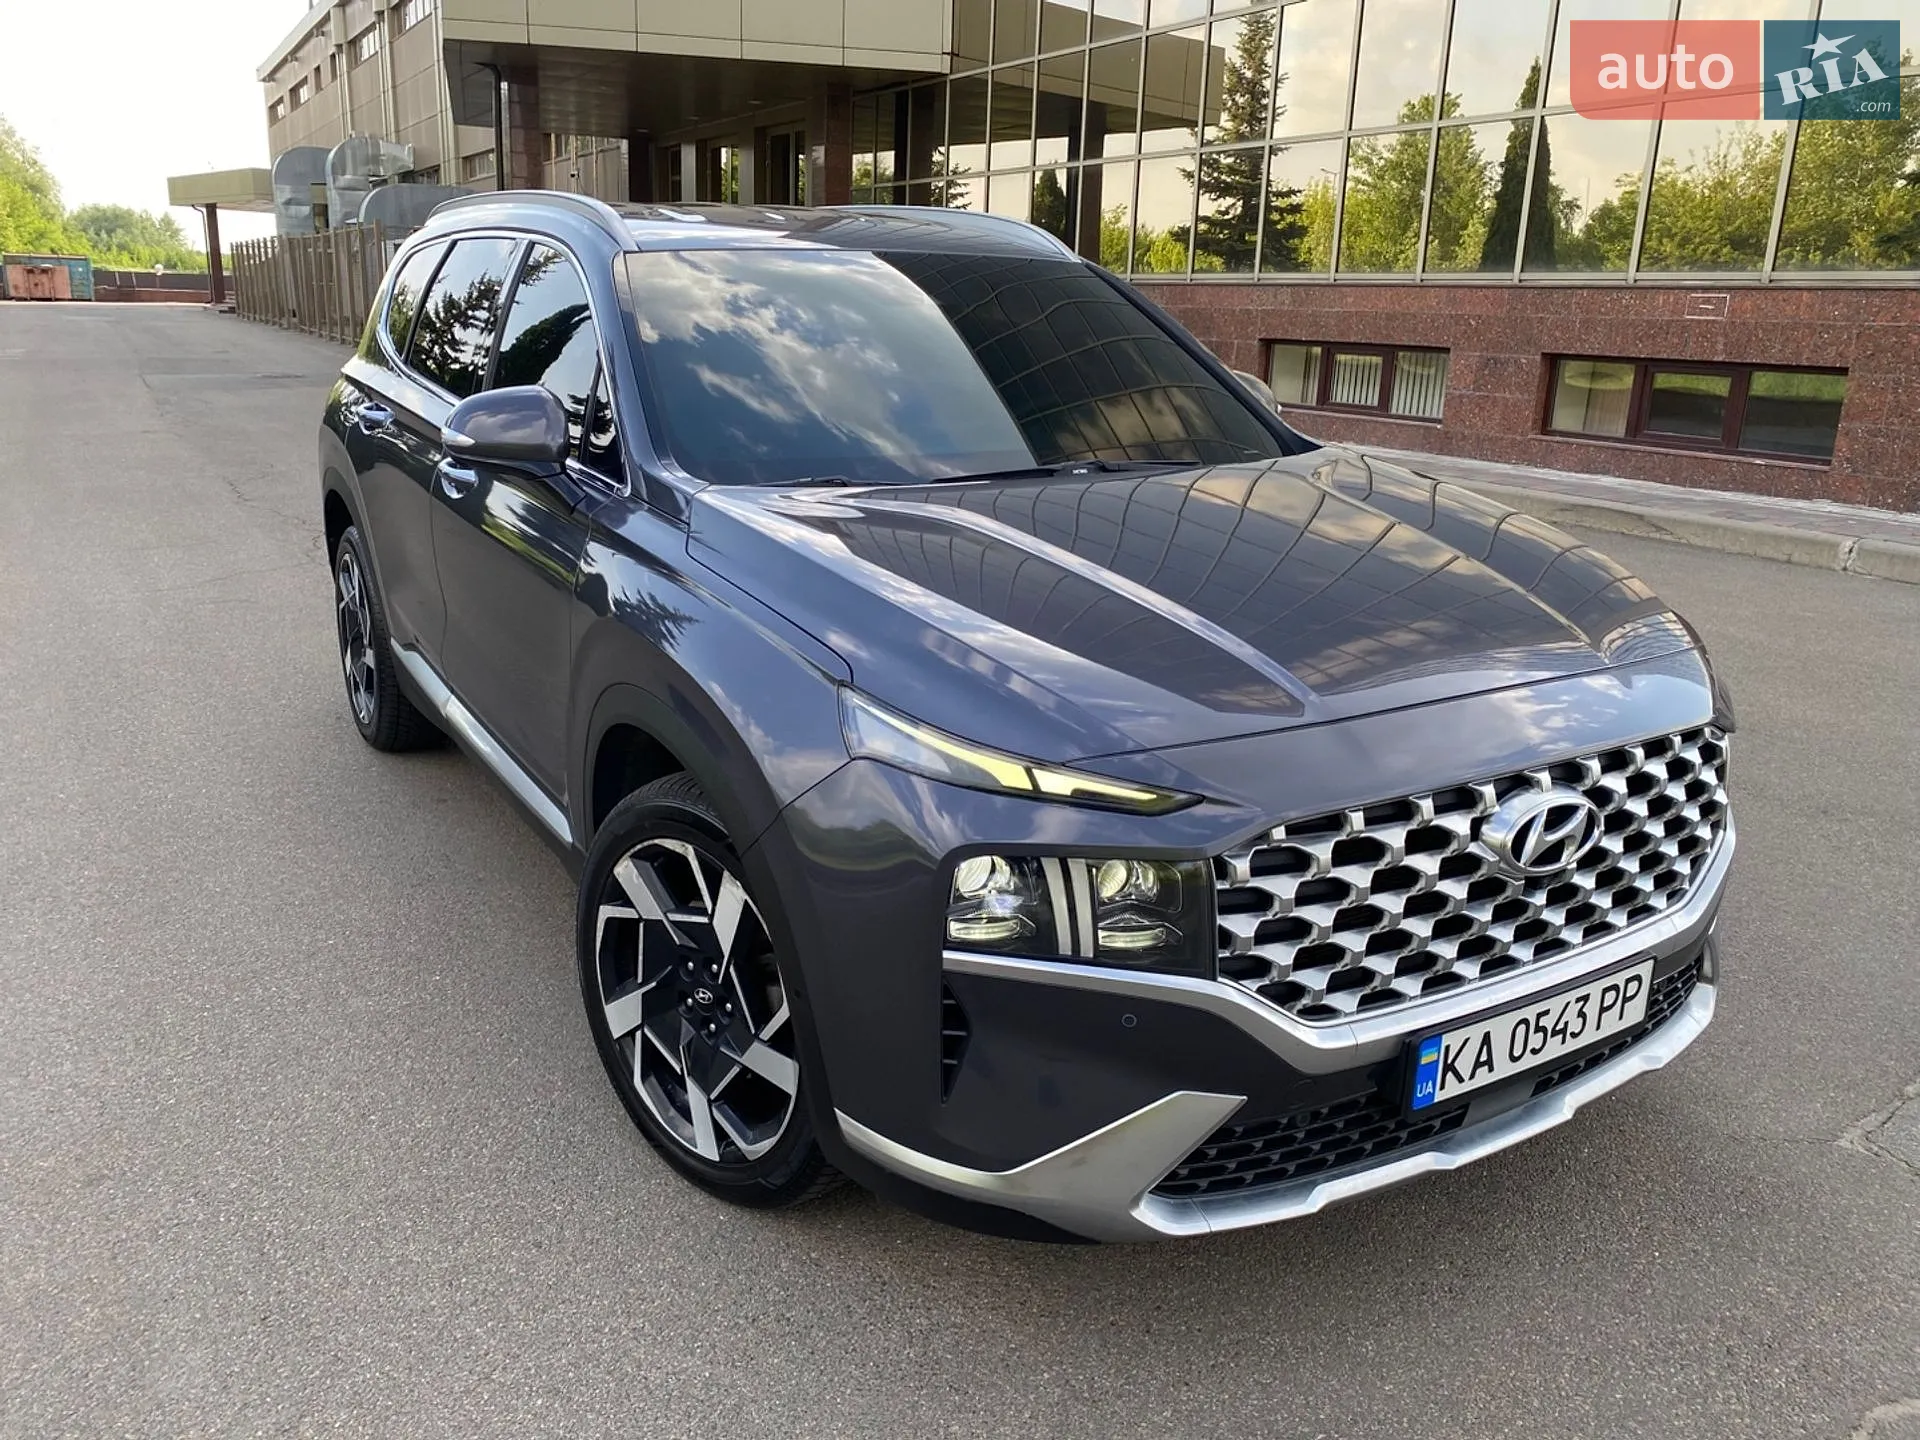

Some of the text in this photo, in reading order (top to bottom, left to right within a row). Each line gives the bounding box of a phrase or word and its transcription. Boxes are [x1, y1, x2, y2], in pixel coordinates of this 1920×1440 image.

[1439, 974, 1643, 1091] KA 0543 PP
[1417, 1080, 1433, 1097] UA
